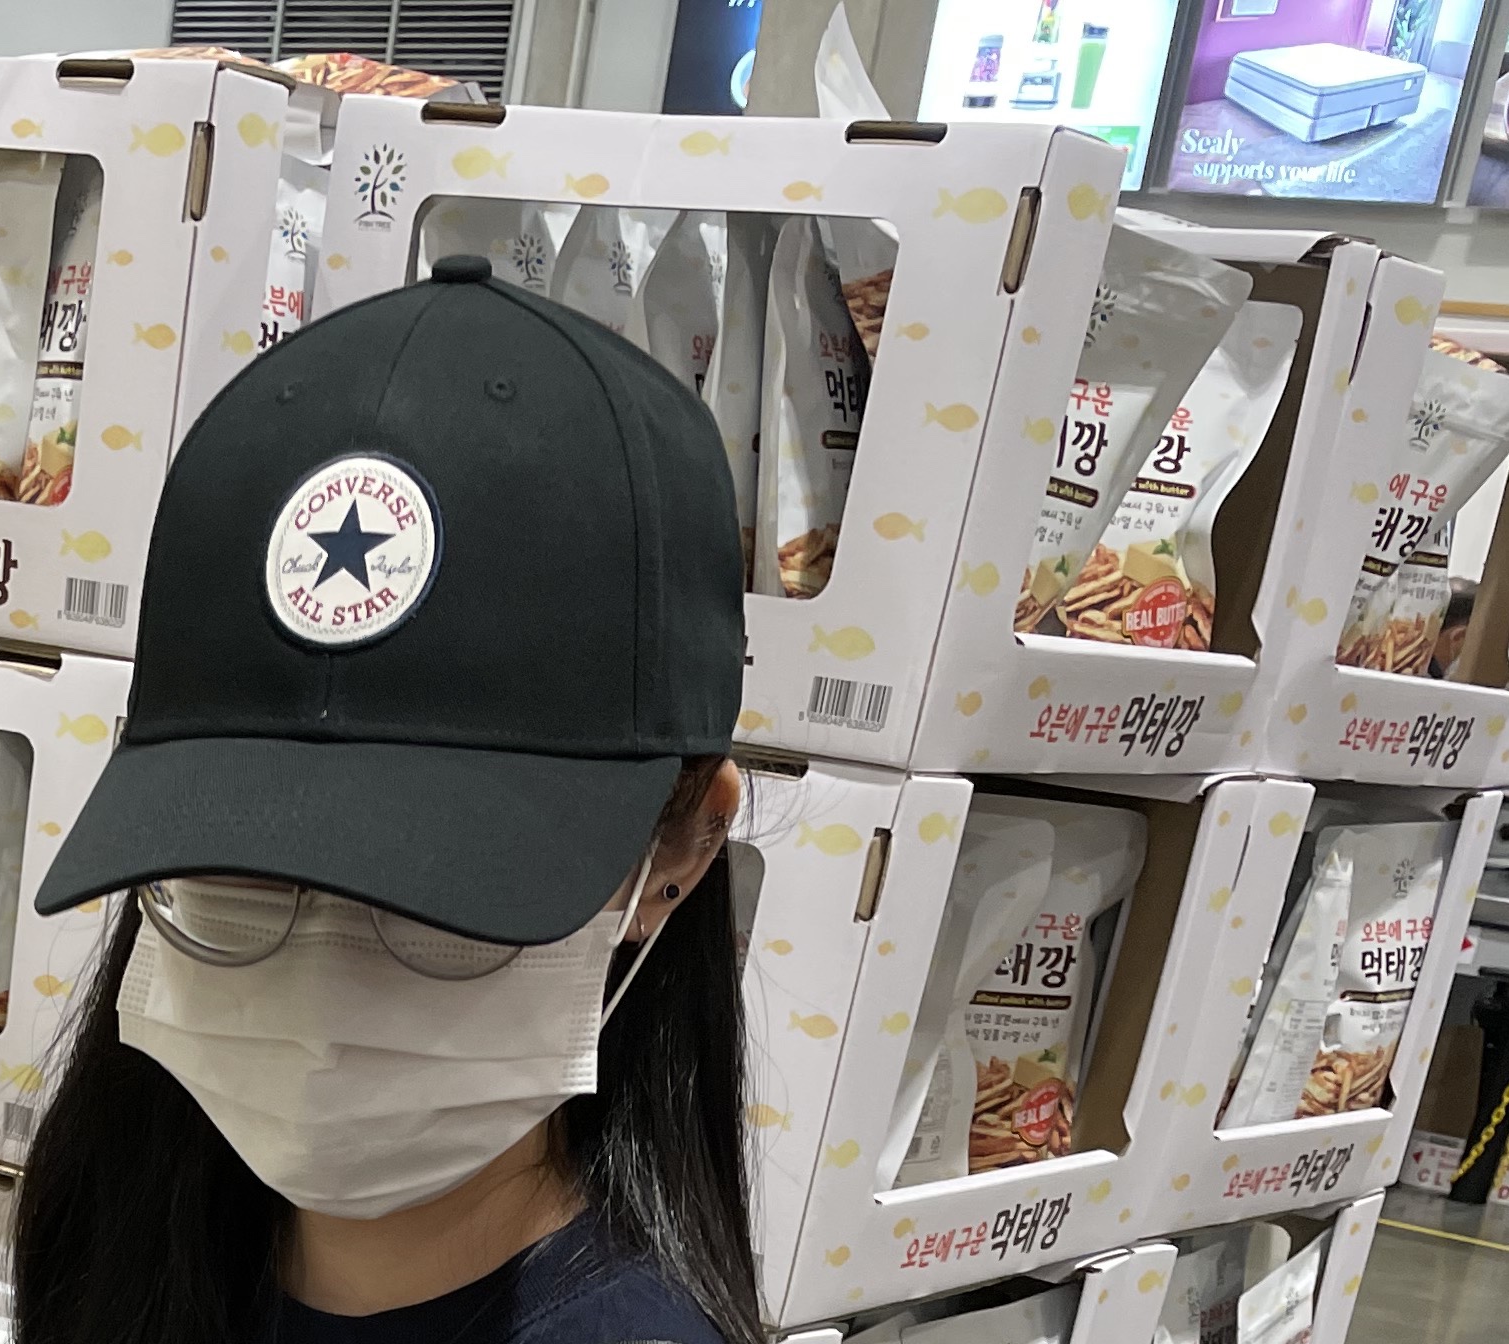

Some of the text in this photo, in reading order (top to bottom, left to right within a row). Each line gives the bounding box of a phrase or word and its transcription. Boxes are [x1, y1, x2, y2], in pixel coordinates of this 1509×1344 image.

[1180, 128, 1245, 162] Sealy
[1192, 160, 1357, 187] supports your life
[1070, 378, 1114, 418] 구운
[295, 475, 418, 531] CONVERSE
[1409, 479, 1449, 513] 구운
[287, 586, 399, 626] ALL STAR
[1126, 609, 1154, 632] REAL
[1029, 693, 1205, 758] 오븐에 구운 먹태깡
[1339, 713, 1475, 770] 오븐에 구운 먹태깡
[1035, 912, 1083, 940] 구운
[1360, 918, 1402, 943] 오븐에
[1223, 1143, 1354, 1199] 오븐에 구운 먹태깡
[899, 1193, 1073, 1271] 오븐에 구운 먹태깡
